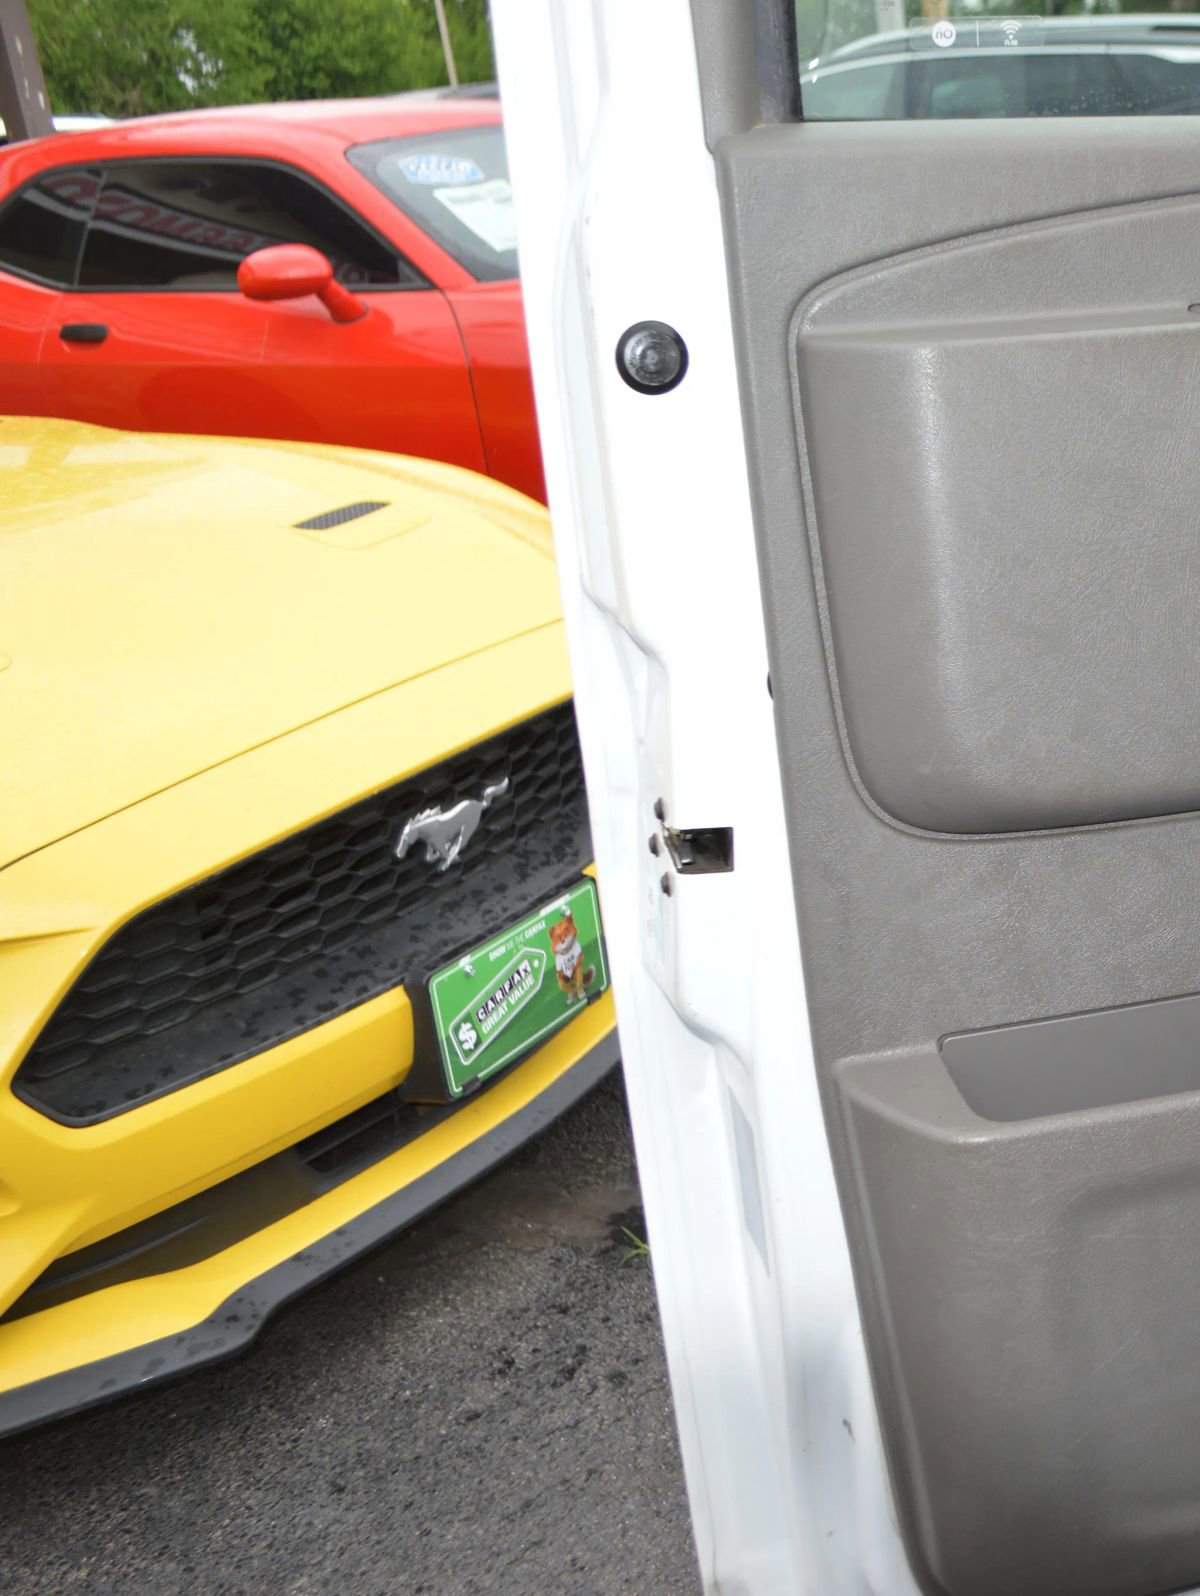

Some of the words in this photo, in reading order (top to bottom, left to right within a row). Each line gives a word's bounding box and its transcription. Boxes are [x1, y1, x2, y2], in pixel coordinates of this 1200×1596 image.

[476, 959, 531, 1022] CARFAX
[482, 1002, 508, 1034] GREAT
[508, 972, 535, 1005] VALUE
